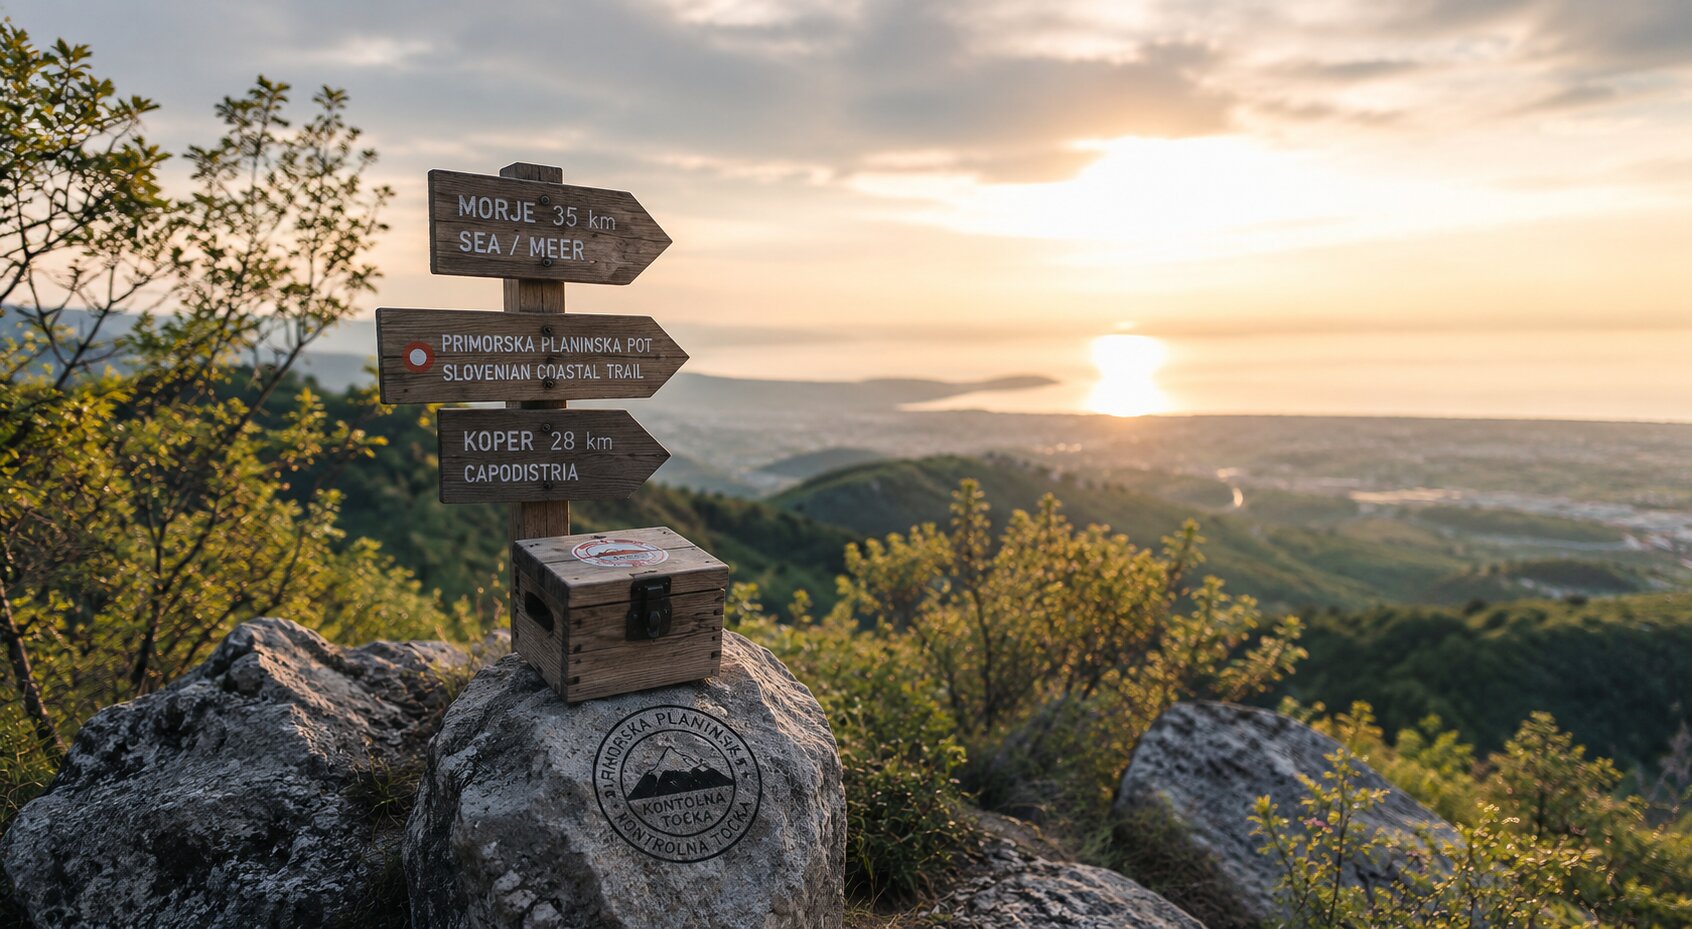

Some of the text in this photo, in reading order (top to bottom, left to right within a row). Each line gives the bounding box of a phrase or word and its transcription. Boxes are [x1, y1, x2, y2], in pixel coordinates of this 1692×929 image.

[458, 194, 616, 230] MORJE 35 km
[459, 230, 585, 261] SEA / MEER
[442, 334, 652, 353] PRIMORSKA PLANINSKA POT
[443, 363, 644, 381] SLOVENIAN COASTAL TRAIL
[463, 430, 613, 451] KOPER 28 km
[464, 463, 579, 483] CAPODISTRIA
[643, 792, 726, 815] KONTOLNA
